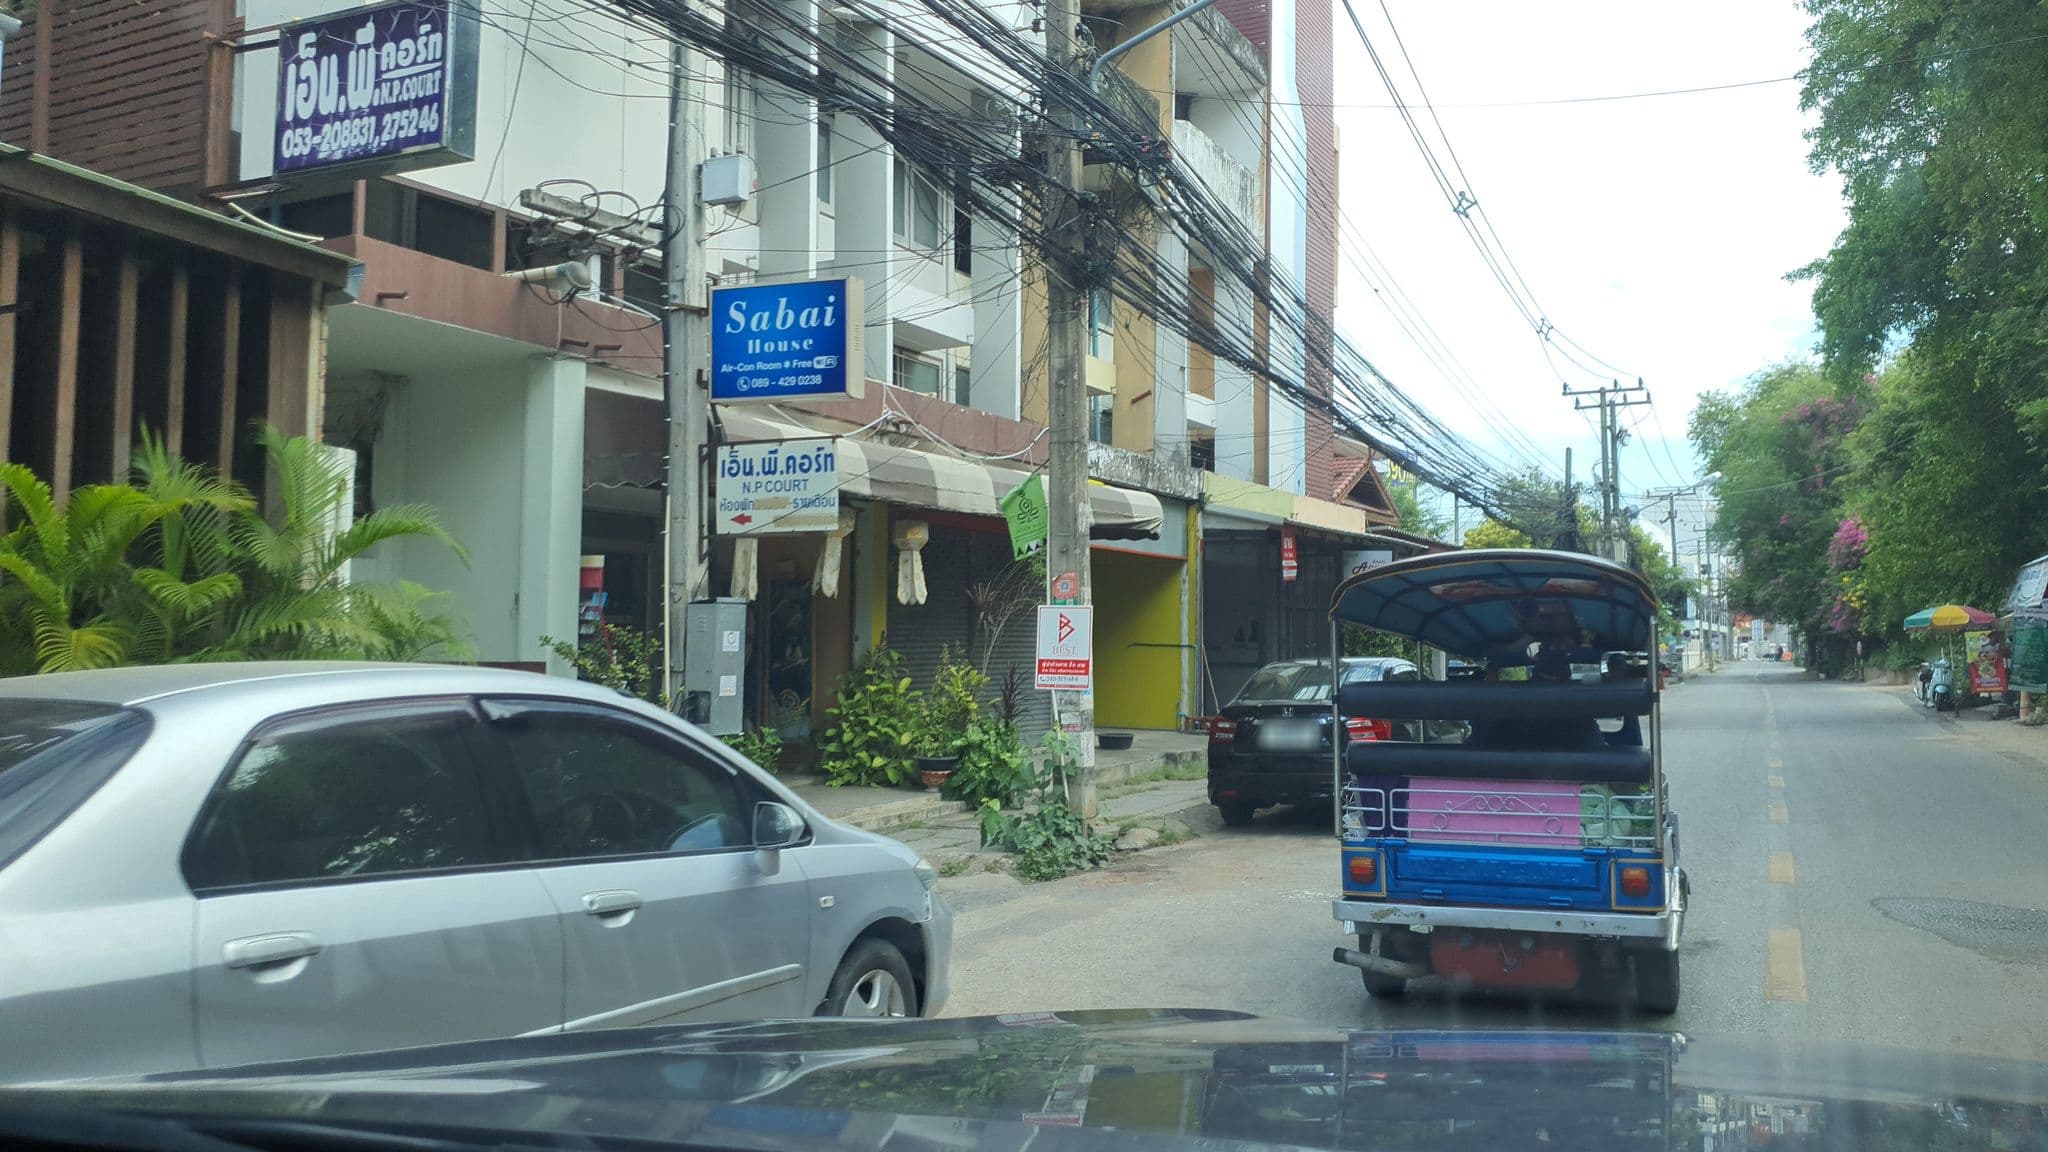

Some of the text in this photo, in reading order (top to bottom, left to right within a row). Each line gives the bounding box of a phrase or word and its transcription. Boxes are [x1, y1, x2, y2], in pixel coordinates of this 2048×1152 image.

[725, 295, 836, 334] Sabai
[747, 338, 814, 354] House
[720, 361, 755, 373] Air-Con
[756, 360, 782, 371] Room
[792, 358, 812, 369] Free
[778, 376, 798, 387] 429
[798, 374, 823, 386] 0238
[765, 479, 809, 493] COURT
